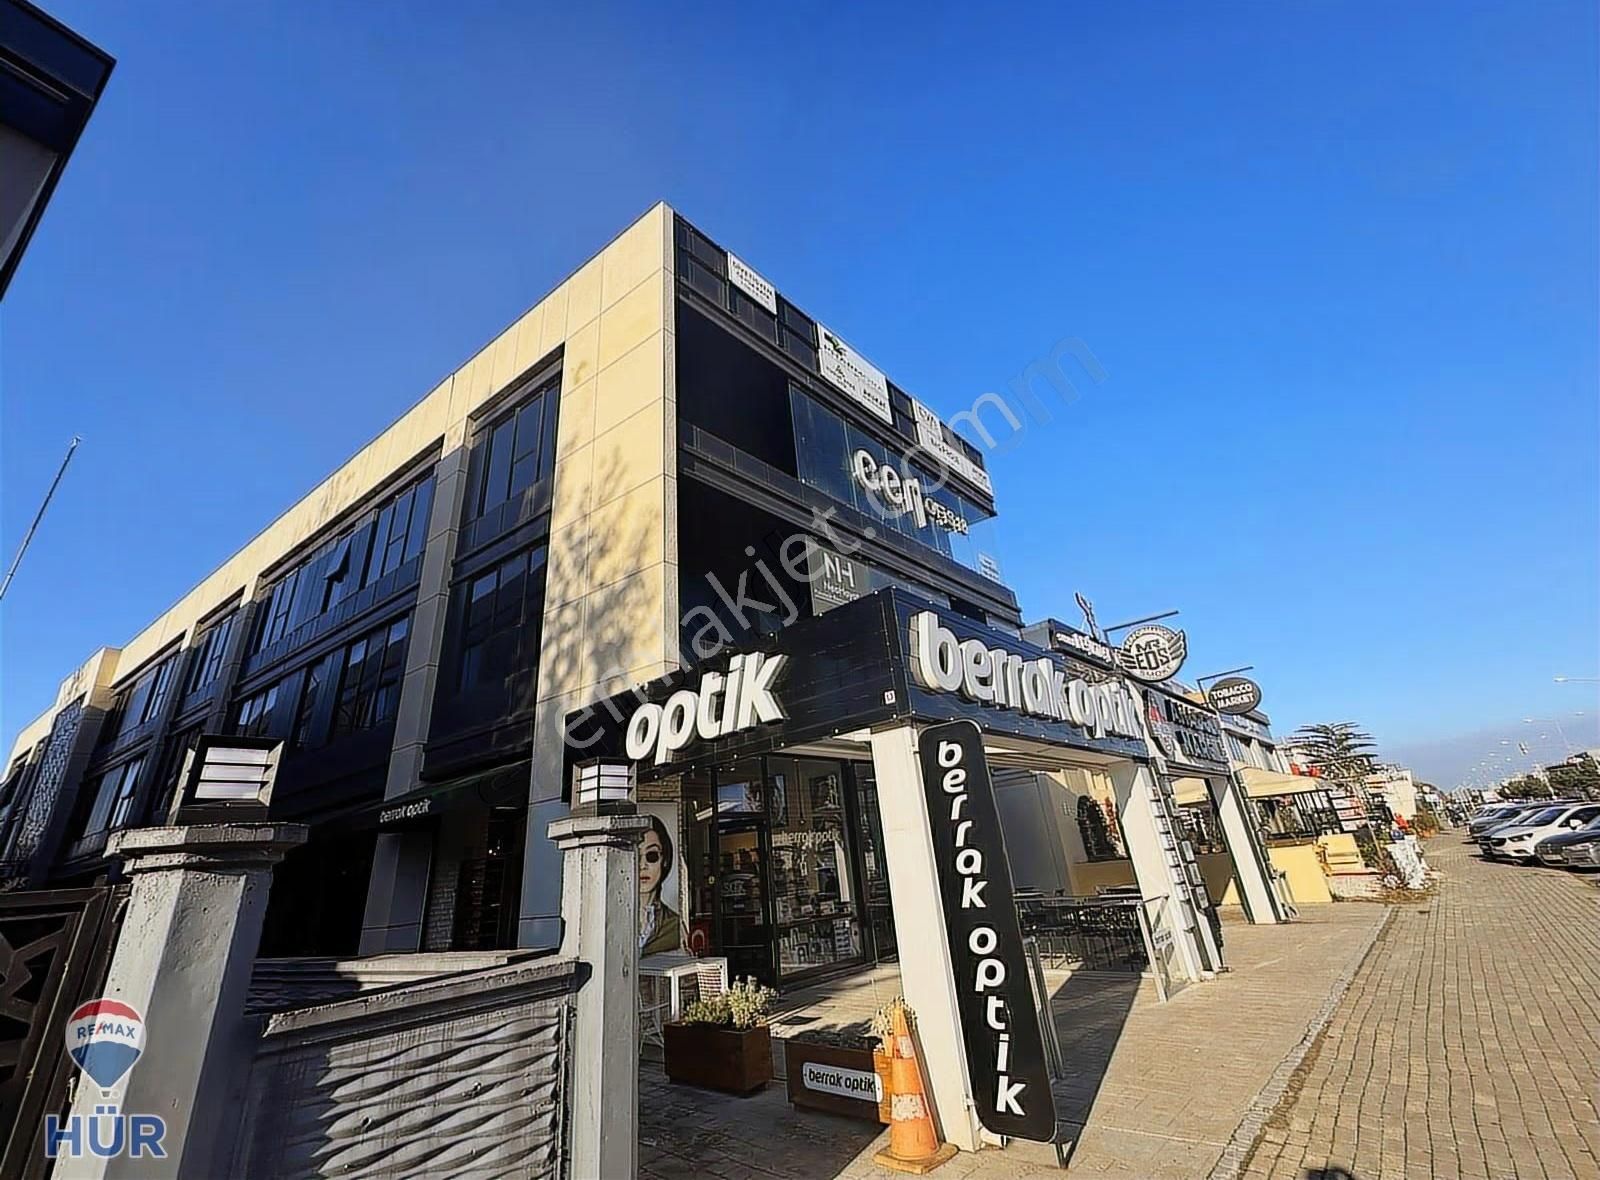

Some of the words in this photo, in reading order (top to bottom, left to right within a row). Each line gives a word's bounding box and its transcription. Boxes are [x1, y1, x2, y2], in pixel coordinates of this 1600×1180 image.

[823, 552, 855, 588] NH
[1135, 647, 1170, 670] EDS
[911, 610, 1069, 721] berrak
[1067, 677, 1144, 740] optik
[1211, 682, 1253, 700] TOBACCO
[1217, 692, 1255, 710] MARKET
[625, 651, 788, 766] optik
[938, 740, 987, 909] berrak
[969, 926, 1027, 1117] optik
[808, 1067, 842, 1089] berrak
[844, 1077, 875, 1093] optik
